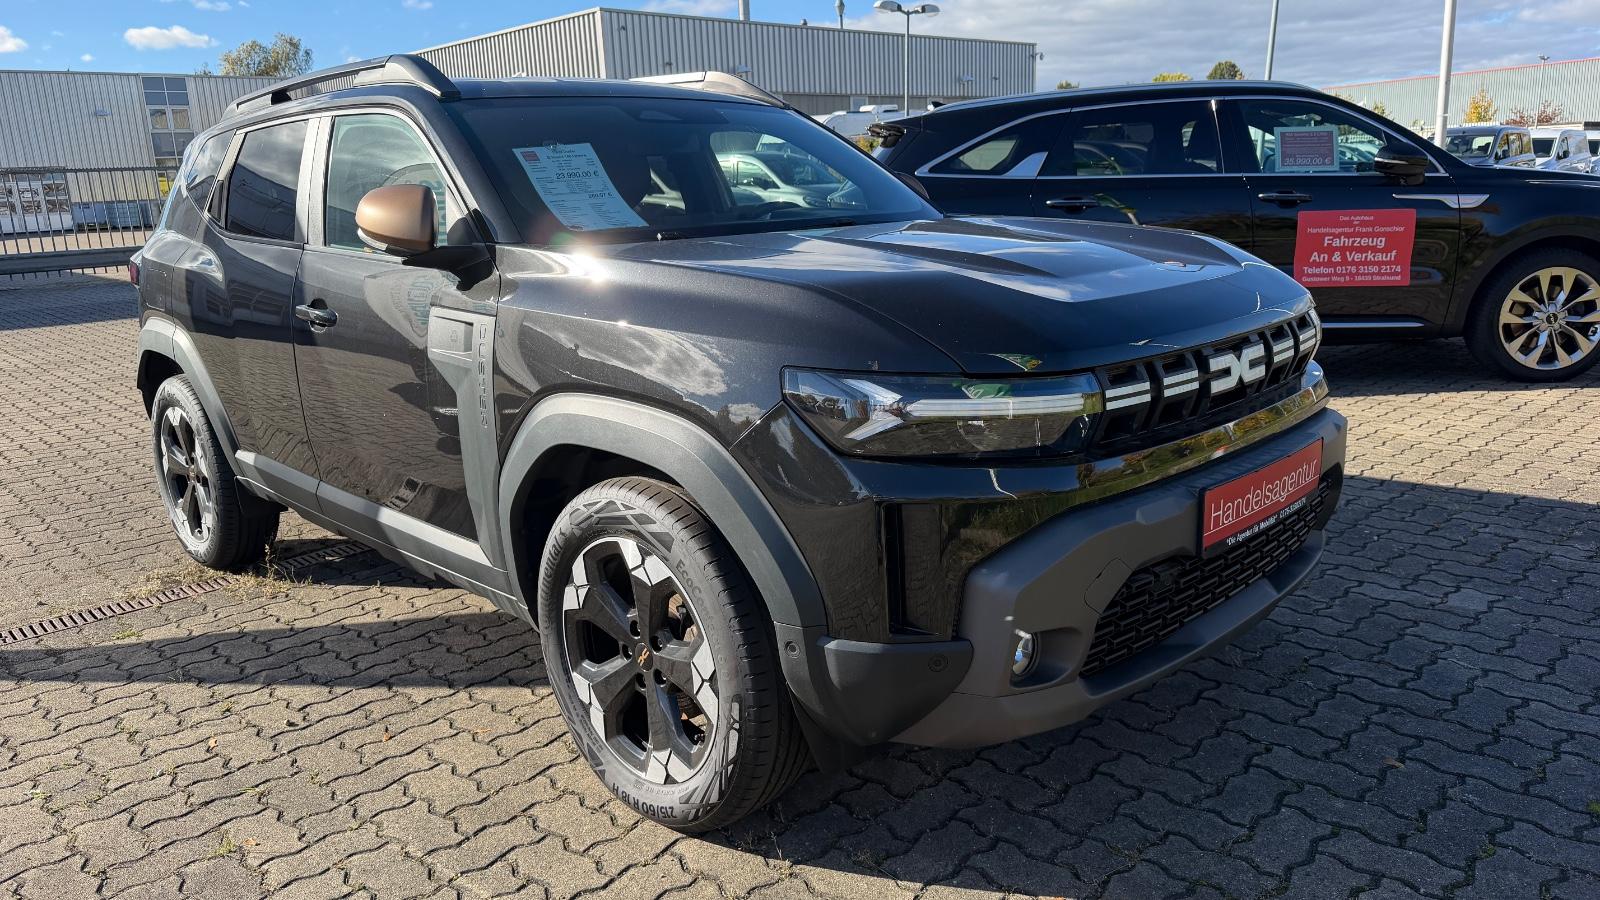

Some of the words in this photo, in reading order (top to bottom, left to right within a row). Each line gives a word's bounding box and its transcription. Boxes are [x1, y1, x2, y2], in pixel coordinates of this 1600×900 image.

[1307, 226, 1354, 234] Handelsagentur
[1324, 235, 1386, 248] Fahrzeug
[1310, 251, 1328, 262] An
[1332, 251, 1342, 262] &
[1346, 250, 1397, 262] Verkauf
[1303, 266, 1334, 274] Telefon
[1359, 265, 1379, 273] 3150
[1381, 265, 1401, 273] 2174
[1331, 275, 1345, 283] Weg
[1210, 458, 1318, 531] Handelsagentur
[612, 783, 620, 796] H
[622, 791, 632, 805] 18
[633, 798, 640, 814] R
[641, 805, 678, 819] 215/60
